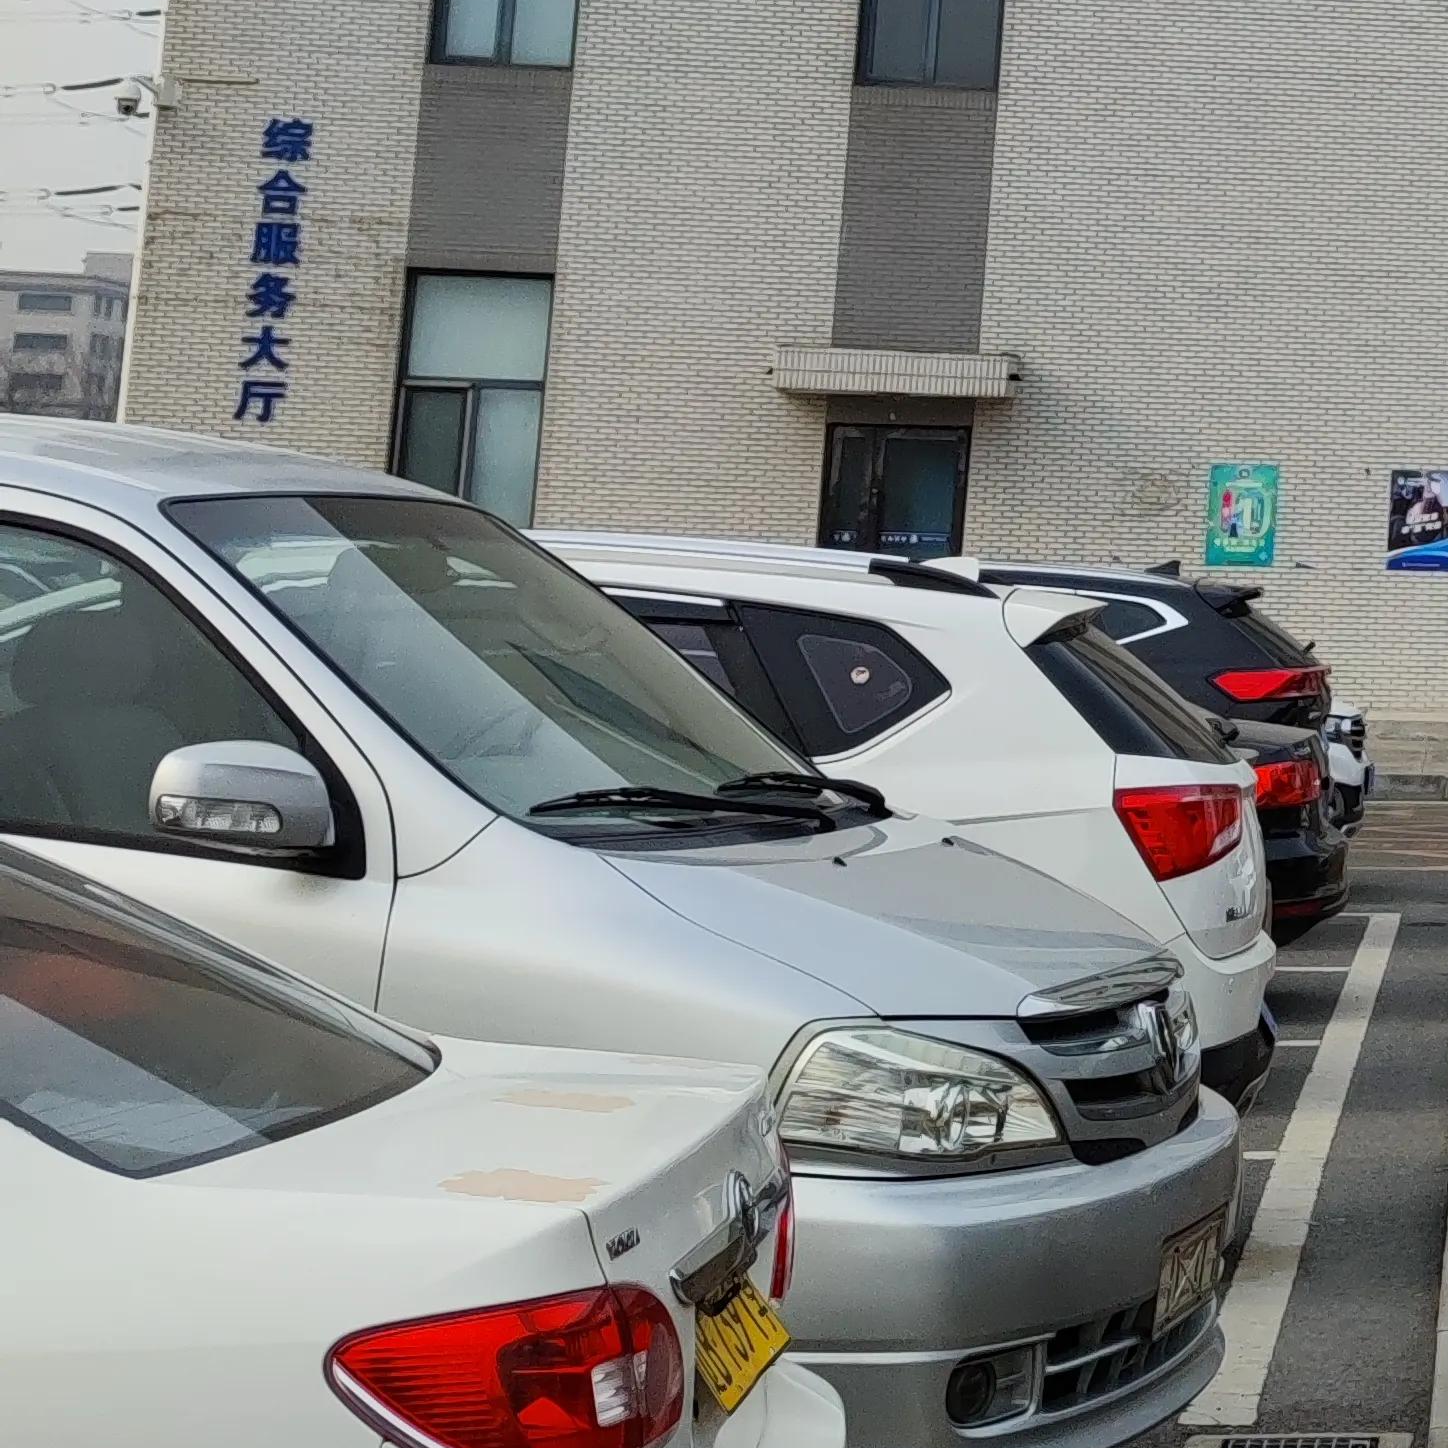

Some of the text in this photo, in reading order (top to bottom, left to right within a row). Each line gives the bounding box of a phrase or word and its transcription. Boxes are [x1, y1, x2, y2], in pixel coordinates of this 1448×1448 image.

[233, 117, 314, 422] 综合服务大厅
